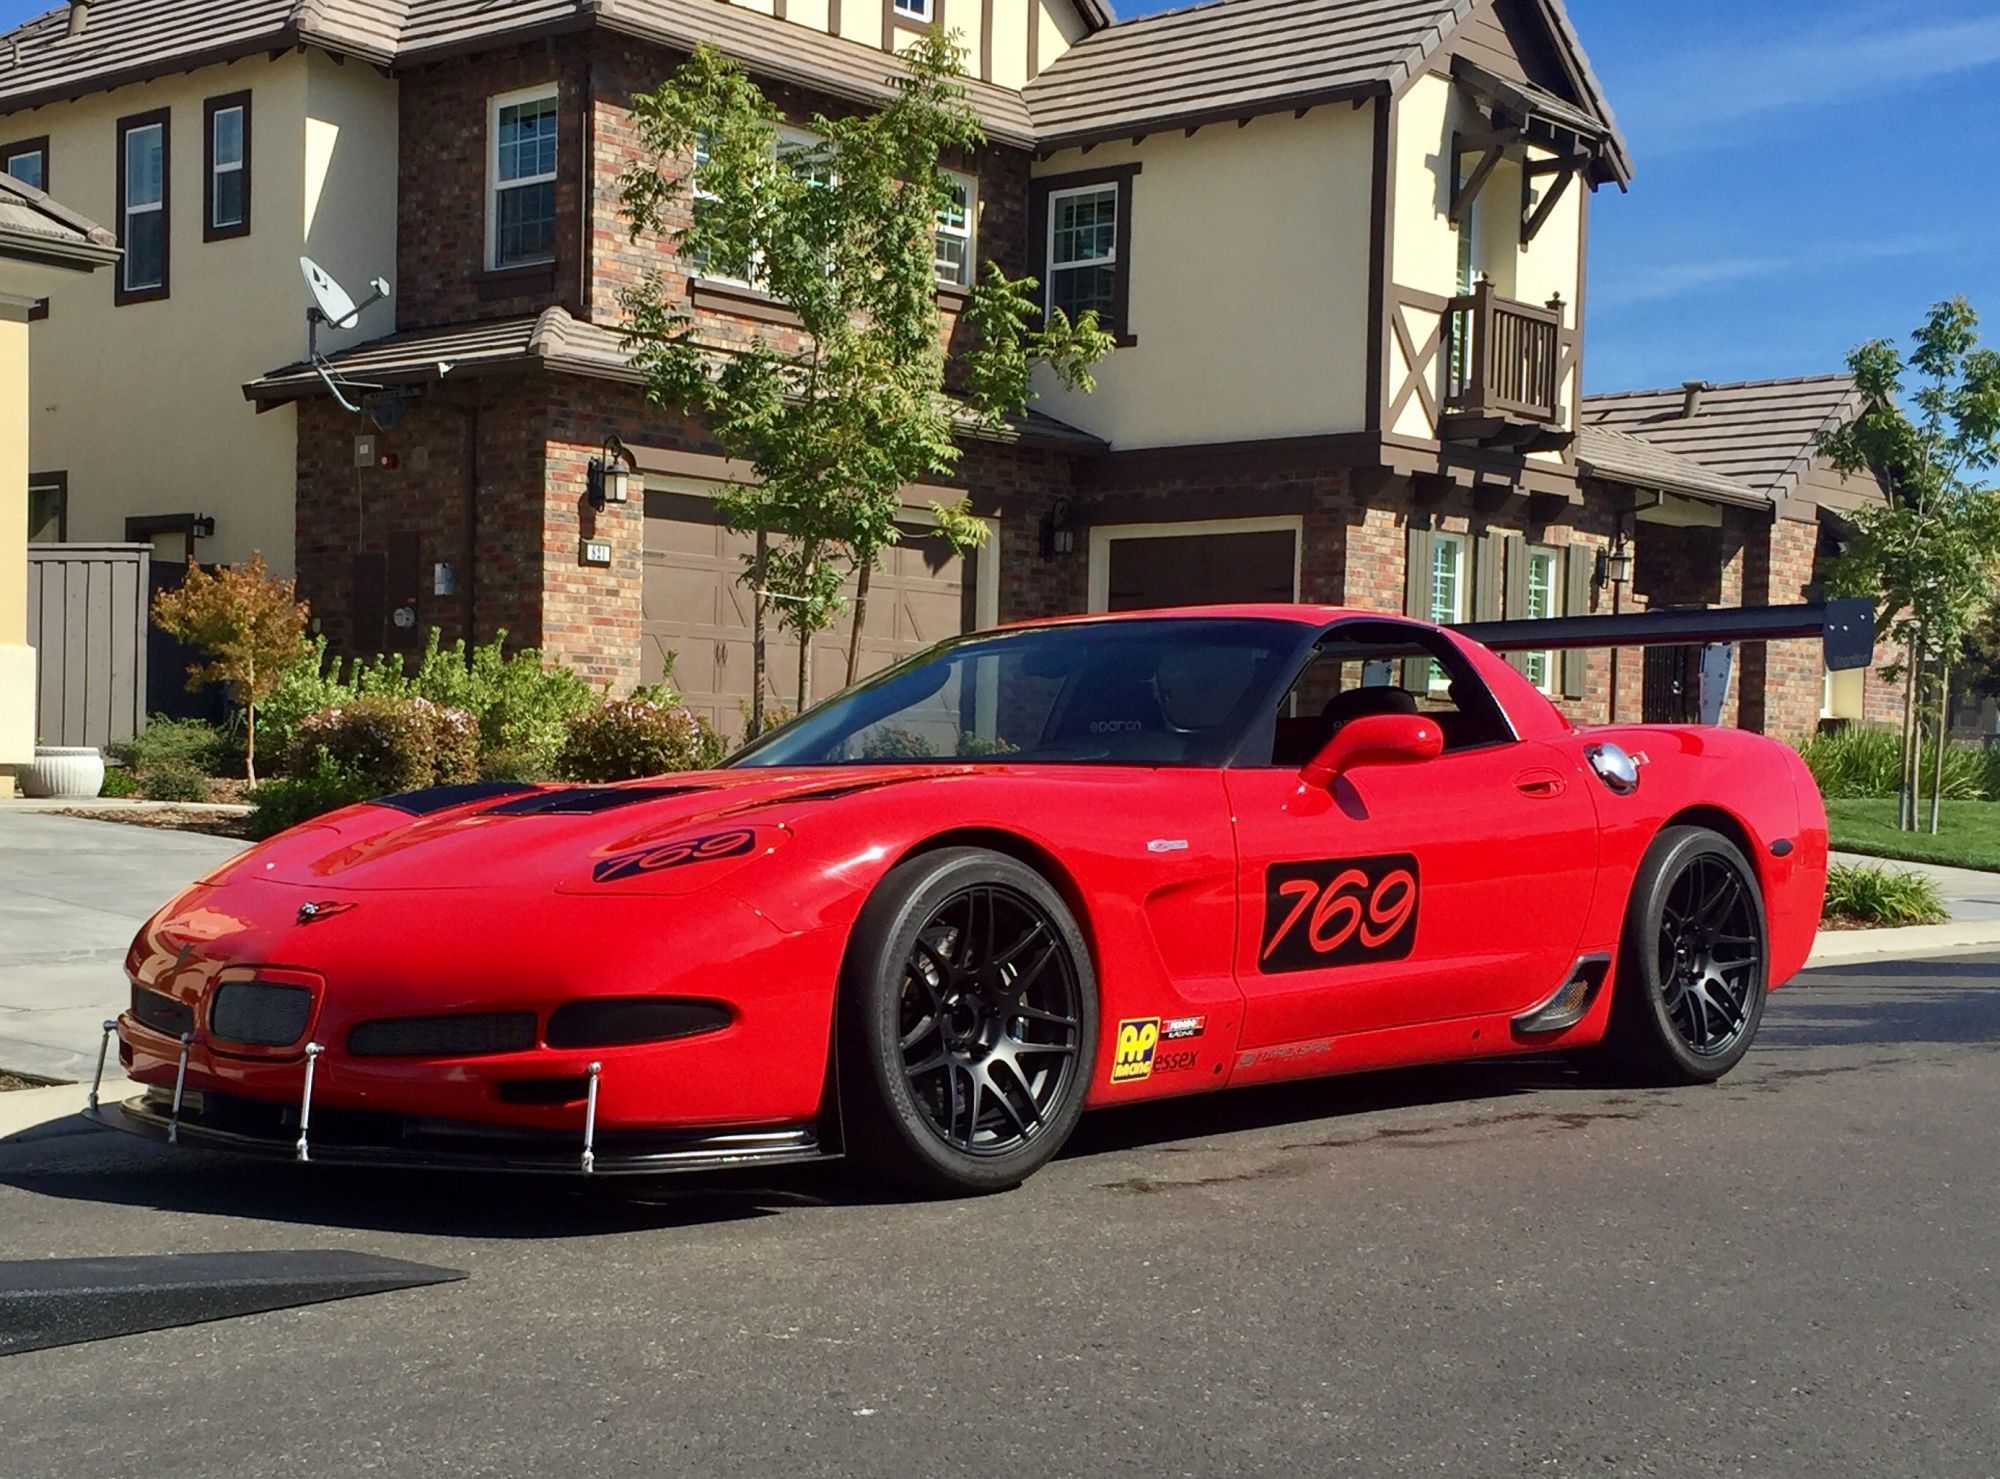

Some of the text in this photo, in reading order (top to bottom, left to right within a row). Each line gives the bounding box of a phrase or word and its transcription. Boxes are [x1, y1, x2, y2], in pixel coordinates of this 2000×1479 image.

[594, 832, 751, 882] 769
[1262, 869, 1416, 961] 769
[1117, 1023, 1157, 1064] AP
[1152, 1050, 1200, 1073] essex
[1114, 1060, 1152, 1077] RACING
